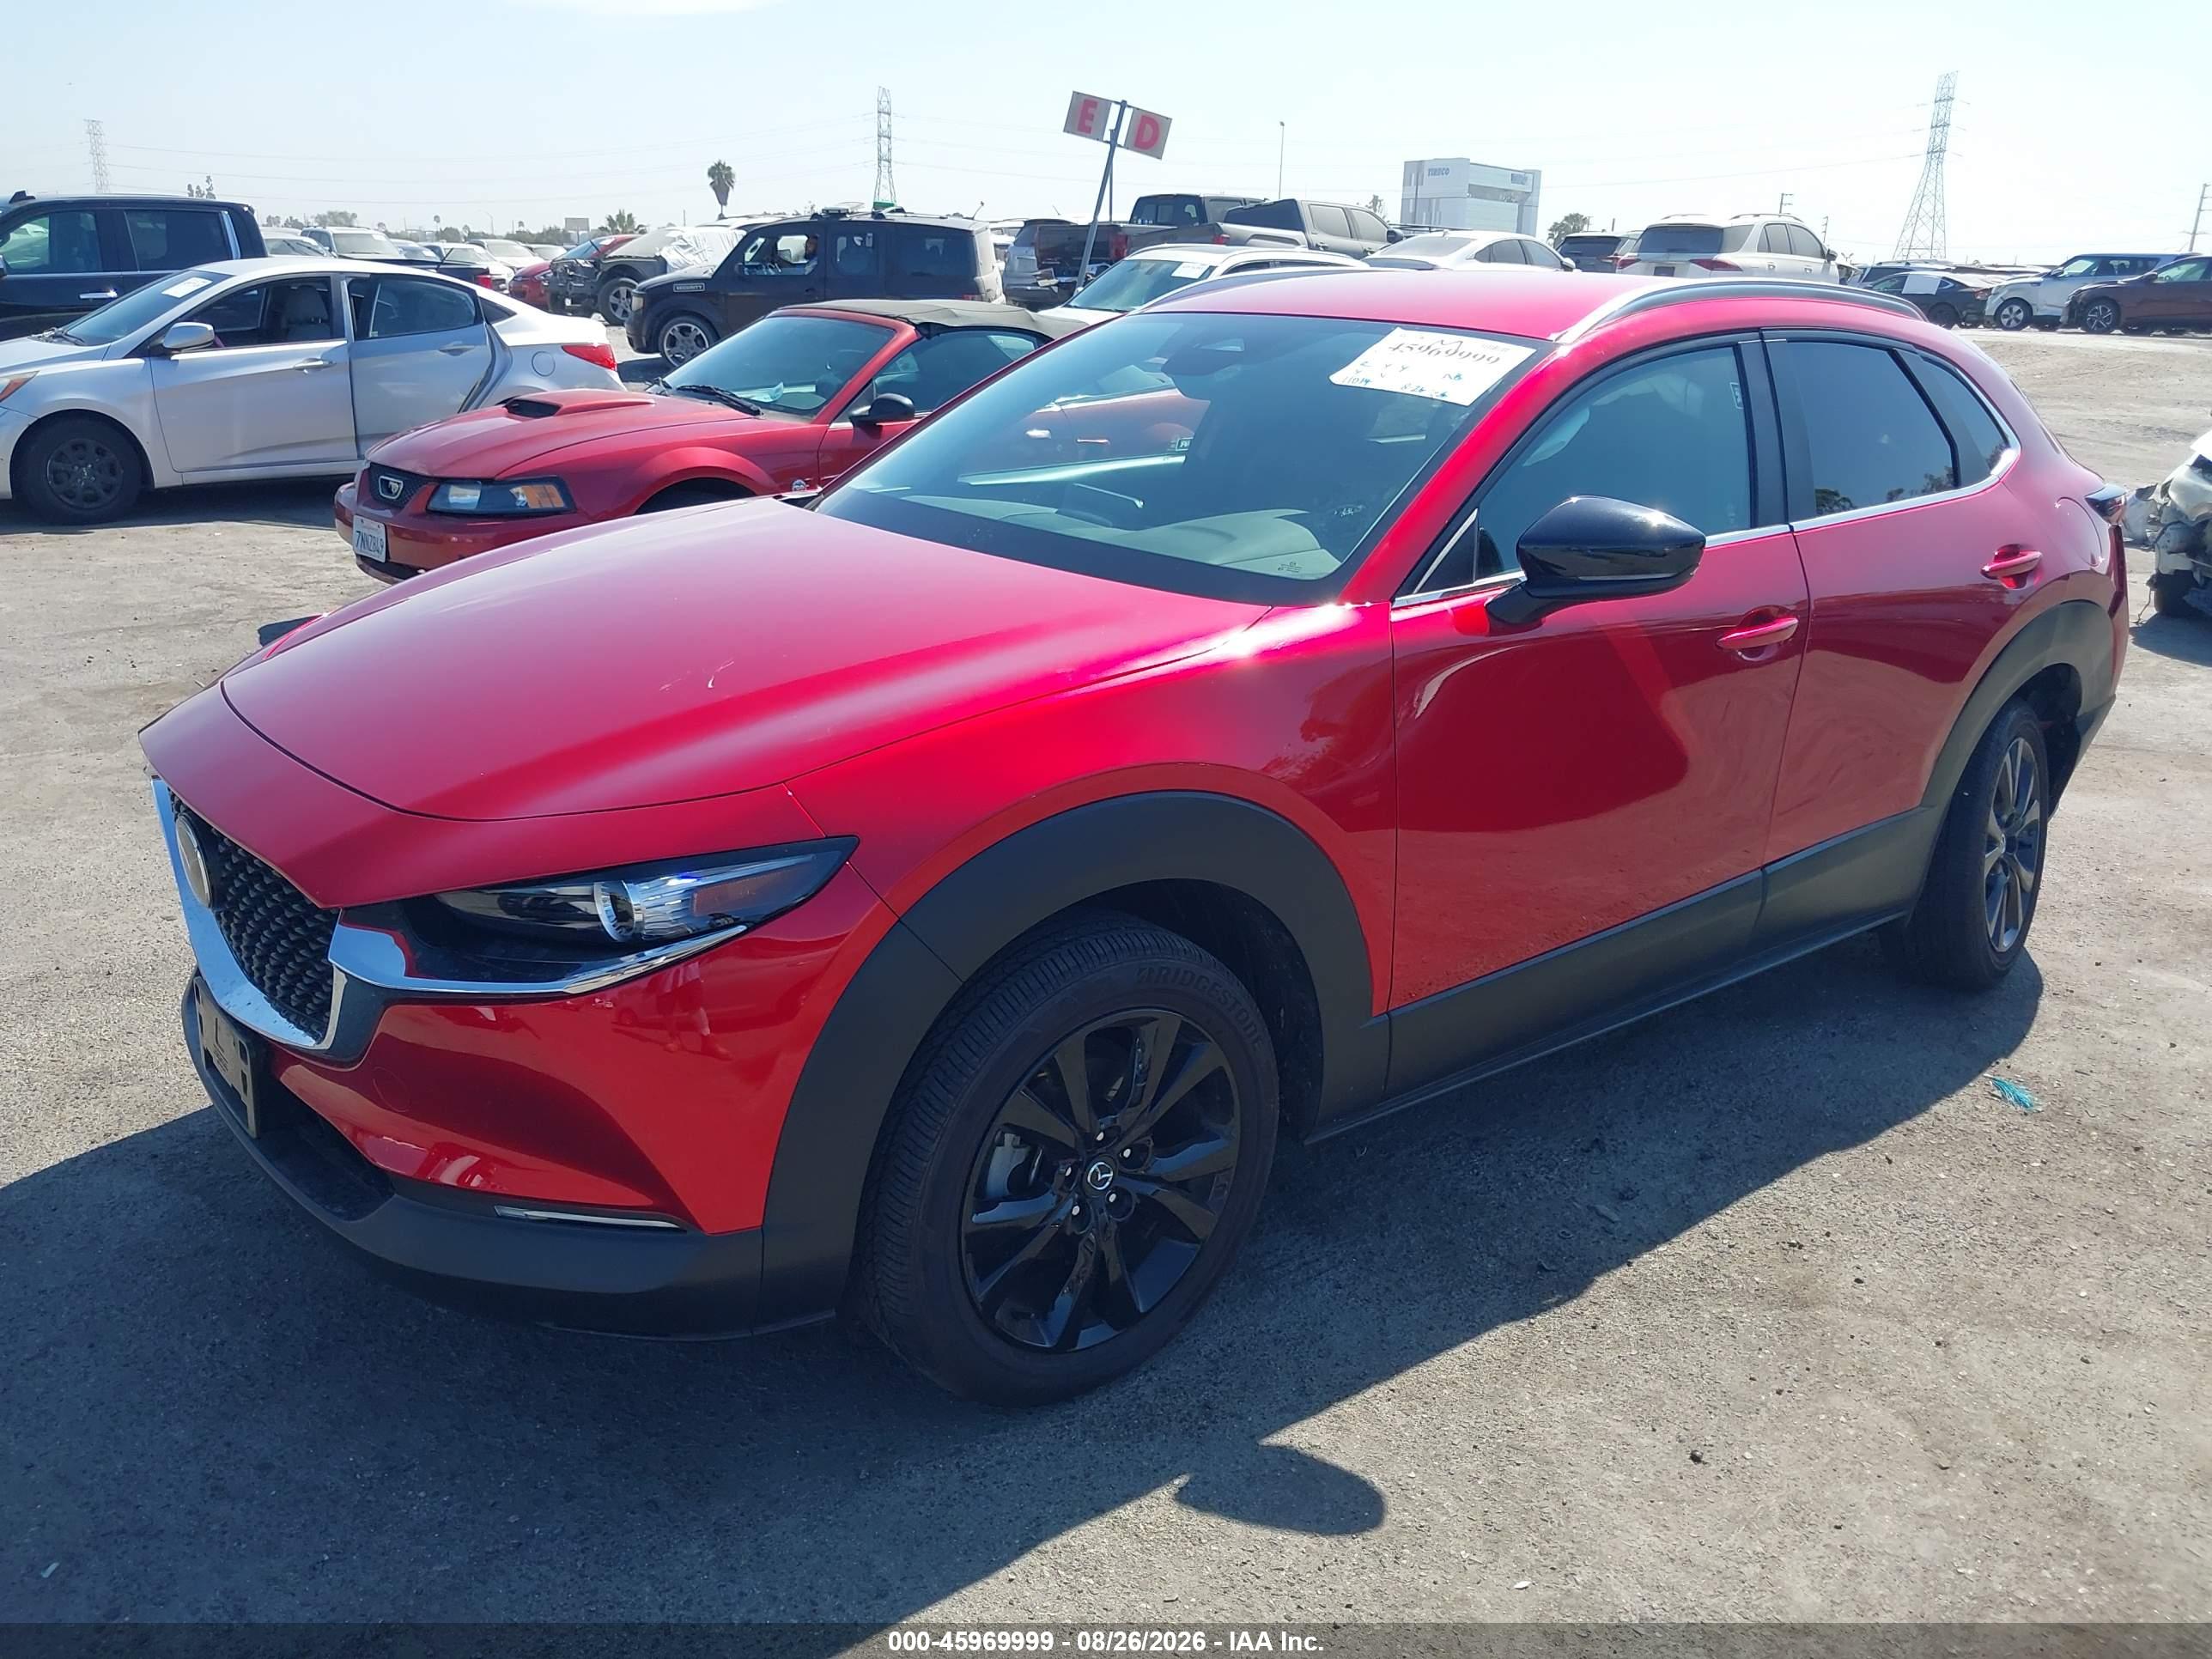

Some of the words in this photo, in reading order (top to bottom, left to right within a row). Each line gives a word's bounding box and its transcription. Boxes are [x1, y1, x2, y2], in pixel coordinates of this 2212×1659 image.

[1077, 99, 1098, 134] E
[1133, 115, 1160, 150] D
[1136, 965, 1263, 1051] BRIDGESTONE
